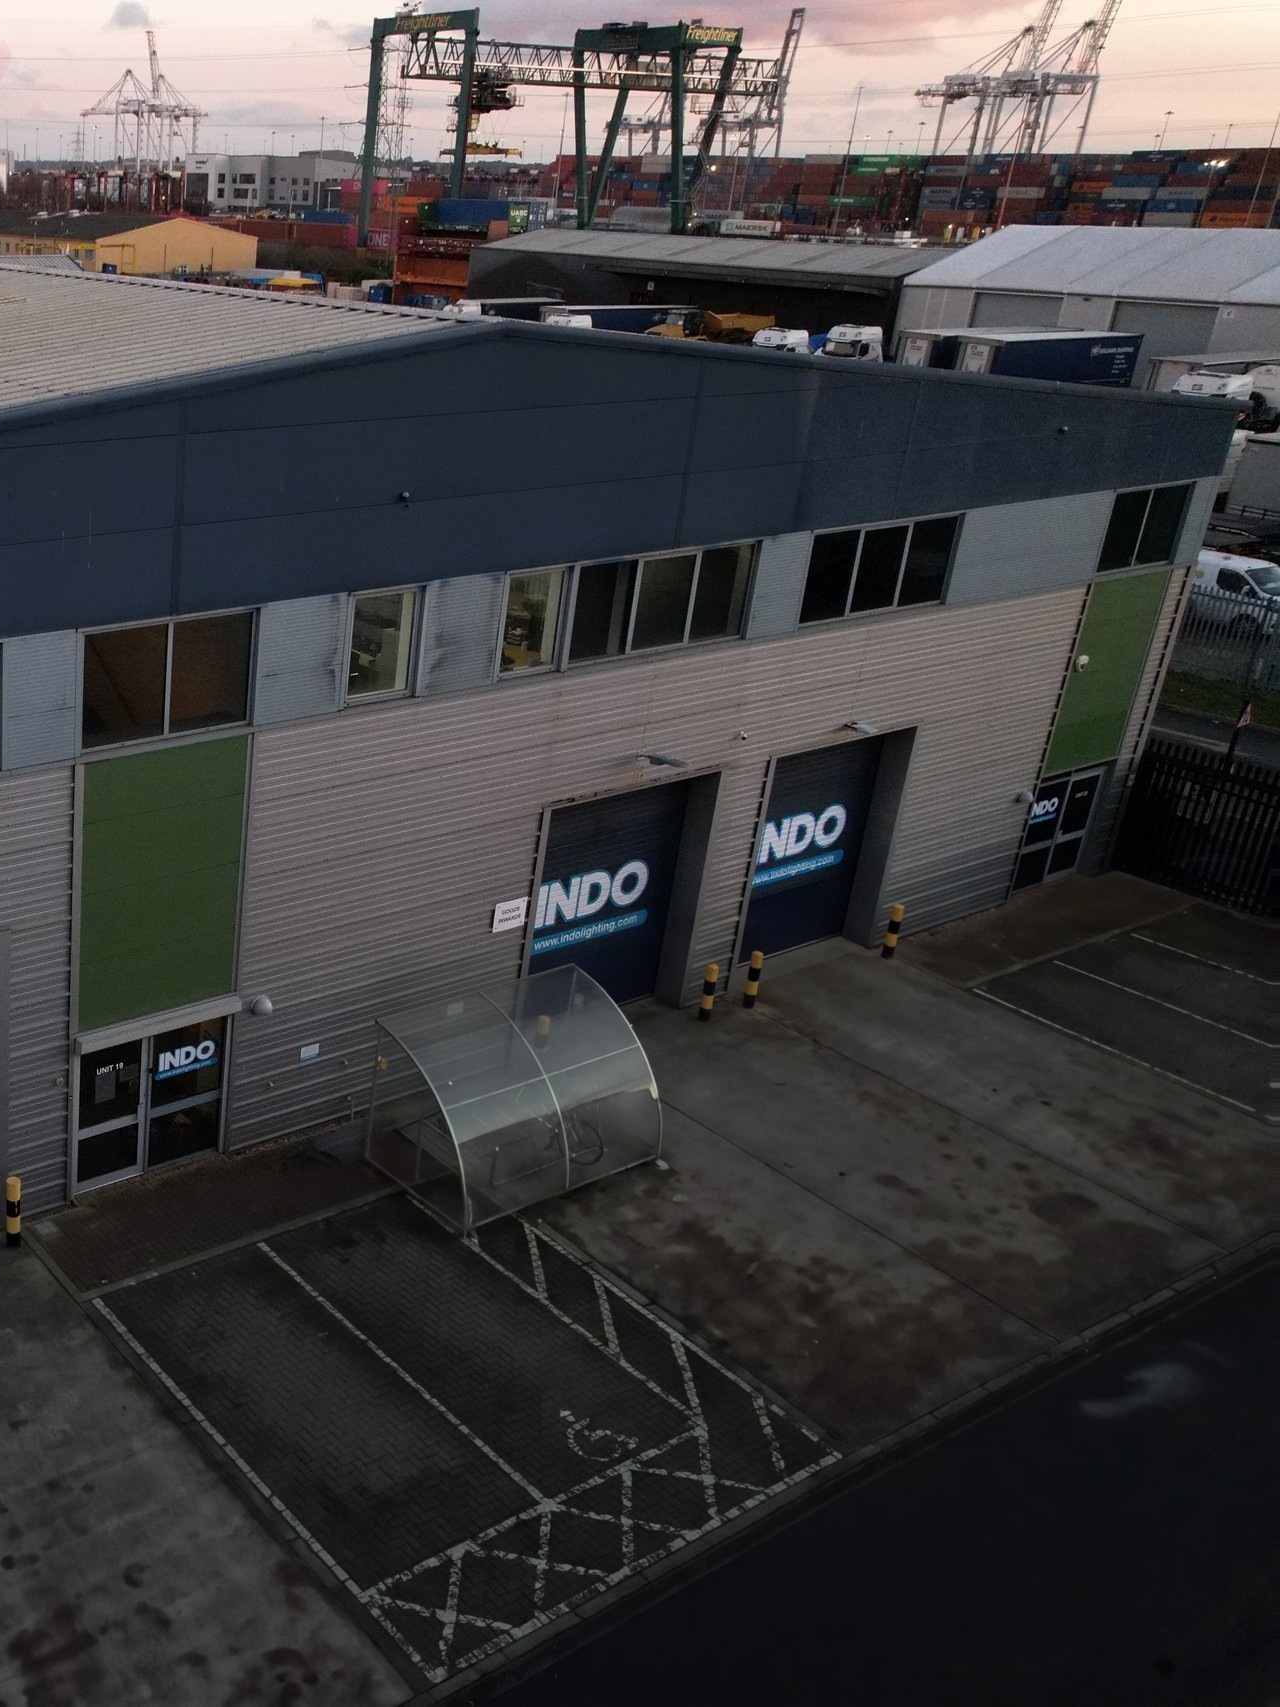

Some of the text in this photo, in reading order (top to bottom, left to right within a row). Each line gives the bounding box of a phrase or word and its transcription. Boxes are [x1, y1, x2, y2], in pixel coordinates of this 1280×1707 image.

[395, 15, 452, 32] Freightliner
[686, 25, 738, 43] Freightliner
[510, 208, 528, 218] UASC
[734, 223, 768, 232] MAERSK
[368, 232, 389, 247] ONE
[1030, 796, 1059, 818] NDO
[756, 804, 848, 865] NDO
[534, 860, 649, 930] INDO
[533, 914, 638, 951] www.indolighting.com
[157, 1040, 216, 1073] INDO
[96, 1061, 124, 1076] UNIT 19
